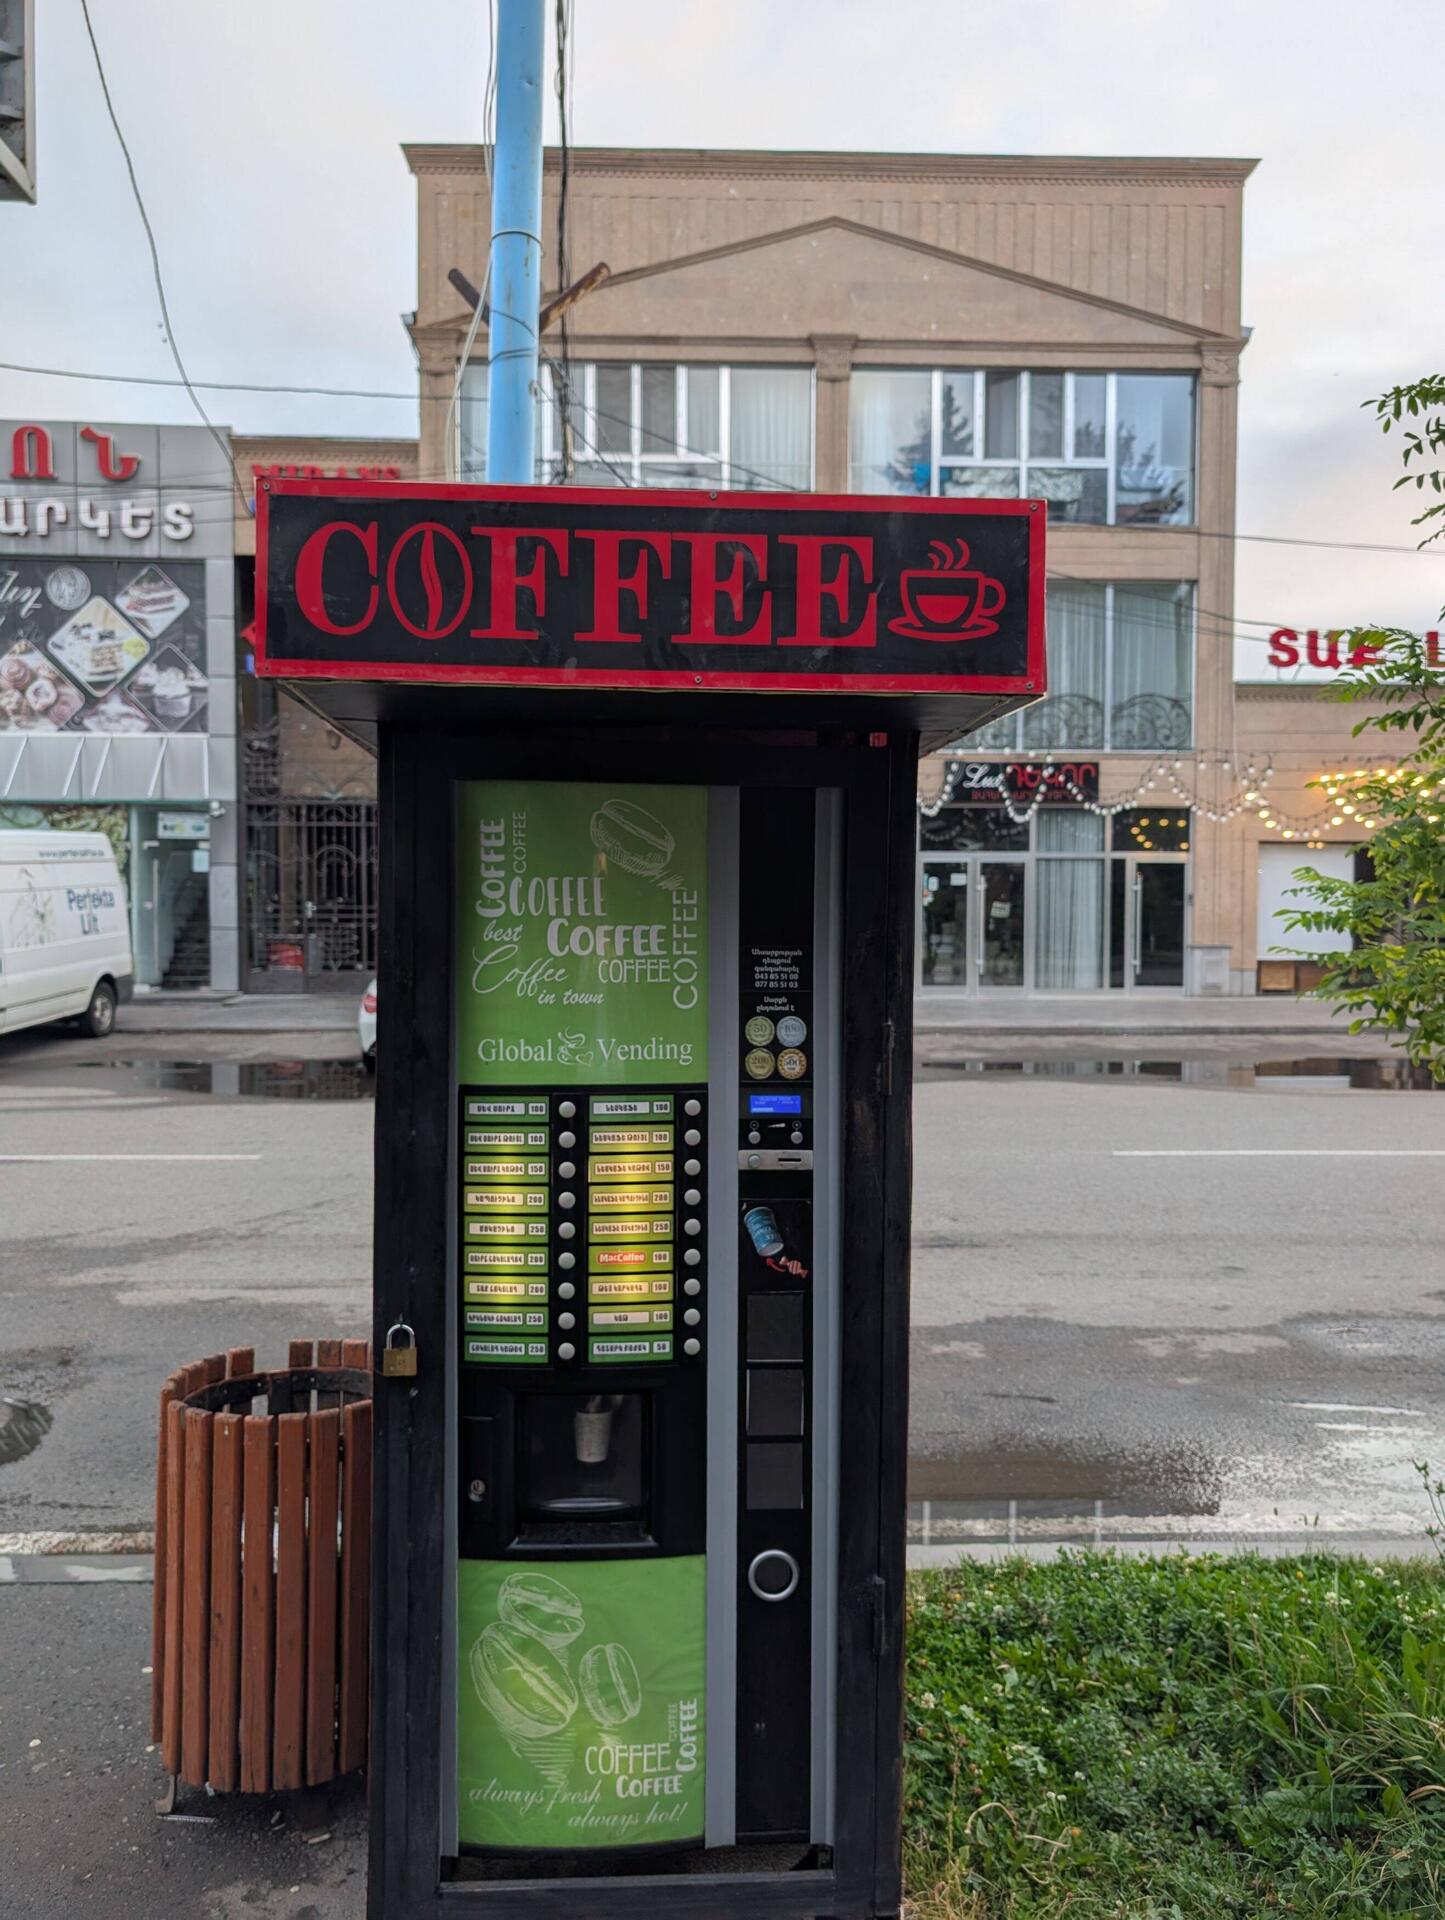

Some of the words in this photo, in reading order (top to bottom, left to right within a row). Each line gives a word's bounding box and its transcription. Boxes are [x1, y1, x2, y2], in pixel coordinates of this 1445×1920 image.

[295, 520, 878, 648] COFFEE
[512, 810, 527, 874] COFFEE
[475, 818, 506, 918] COFFEE
[509, 876, 608, 917] COFFEE
[483, 920, 523, 943] best
[546, 918, 667, 957] COFFEE
[672, 890, 698, 1010] COFFEE
[471, 944, 569, 997] Coffee
[598, 959, 671, 984] COFFEE
[537, 988, 556, 1005] in
[562, 989, 605, 1005] town
[478, 1038, 552, 1064] Global
[596, 1036, 693, 1066] Vending
[530, 1225, 544, 1233] 250
[655, 1223, 668, 1231] 250
[529, 1255, 543, 1263] 200
[599, 1253, 645, 1262] MacCoffee
[654, 1253, 667, 1261] 100
[654, 1283, 667, 1291] 100
[527, 1315, 542, 1323] 250
[655, 1312, 668, 1320] 100
[530, 1345, 544, 1353] 250
[657, 1343, 666, 1351] 50
[676, 1698, 698, 1773] COFFEE
[585, 1743, 671, 1775] COFFEE
[469, 1778, 545, 1816] always
[545, 1780, 602, 1815] fresh
[615, 1775, 683, 1798] COFFEE
[568, 1805, 640, 1833] always
[645, 1802, 689, 1822] hot!
